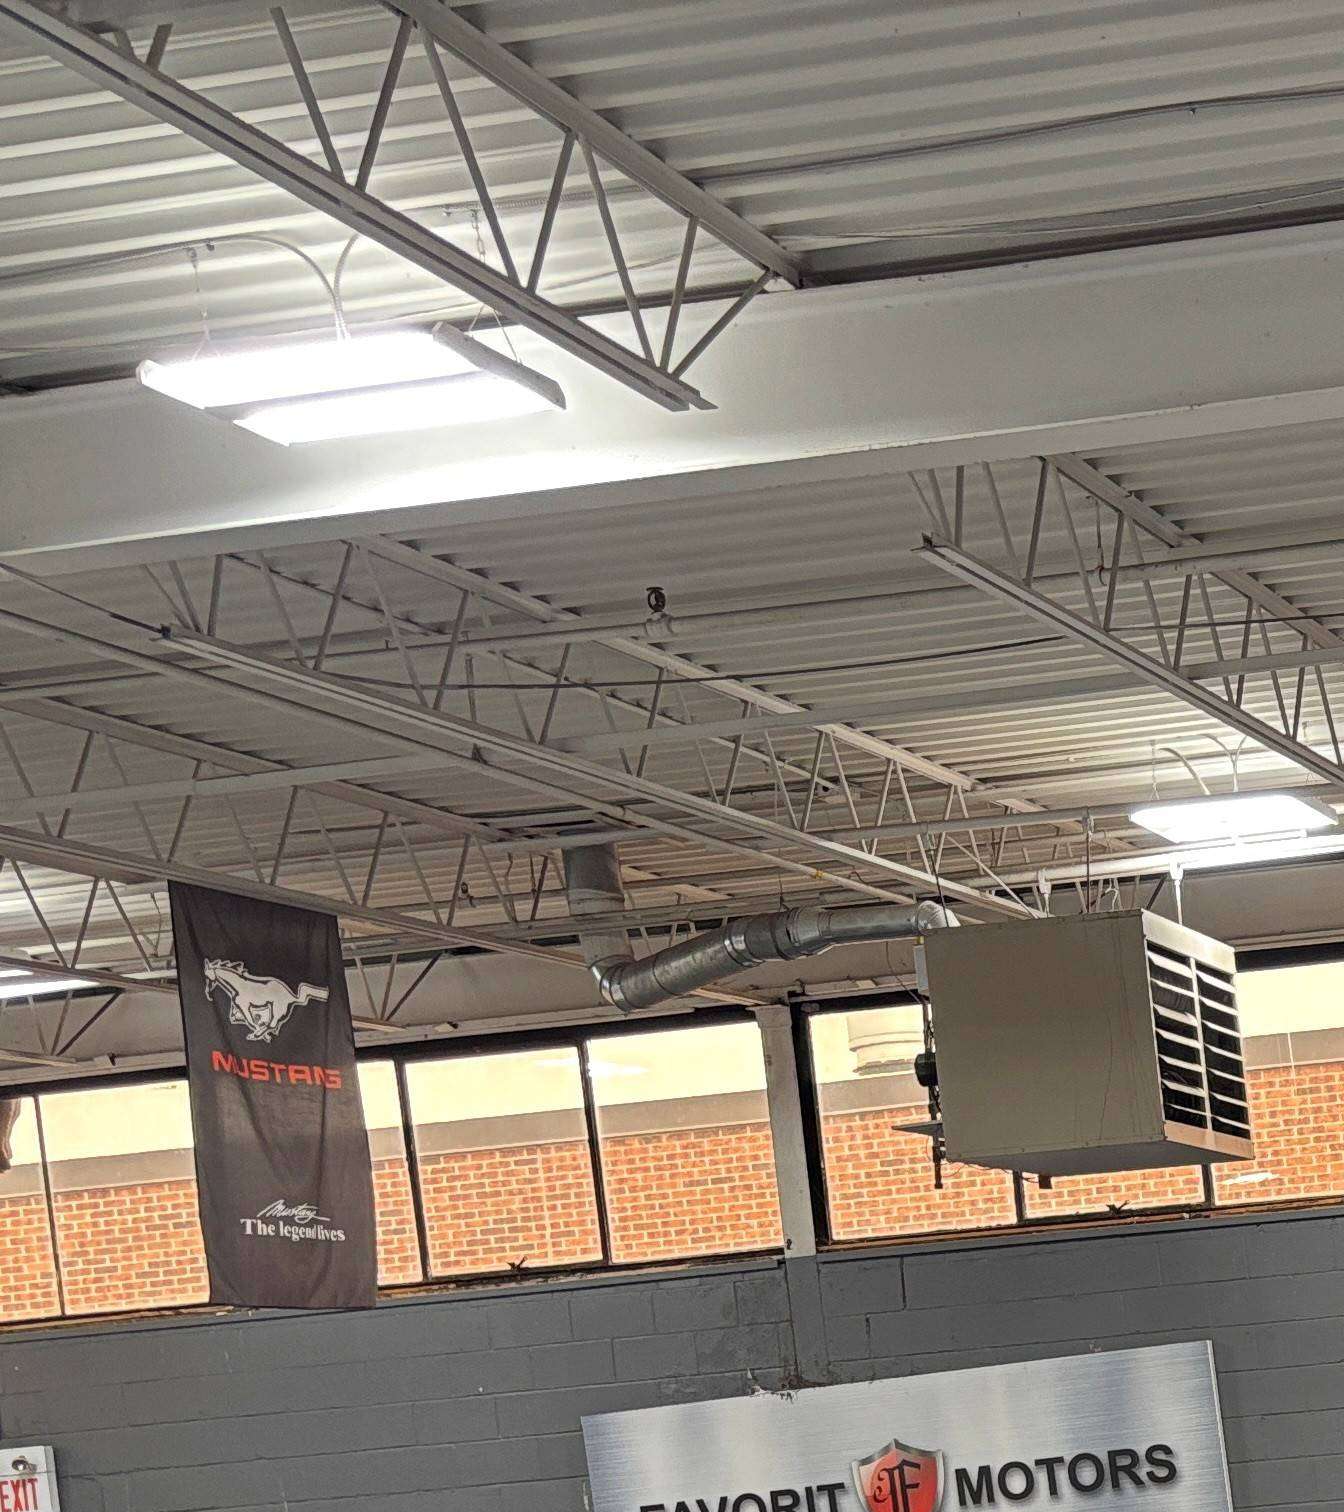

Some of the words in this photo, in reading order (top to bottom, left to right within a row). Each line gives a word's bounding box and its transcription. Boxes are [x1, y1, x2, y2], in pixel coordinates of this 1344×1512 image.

[211, 1050, 342, 1089] MUSTANG
[240, 1218, 276, 1236] The
[279, 1220, 317, 1242] legend
[318, 1224, 346, 1241] lives
[955, 1443, 1178, 1506] MOTORS
[0, 1478, 39, 1512] EXIT
